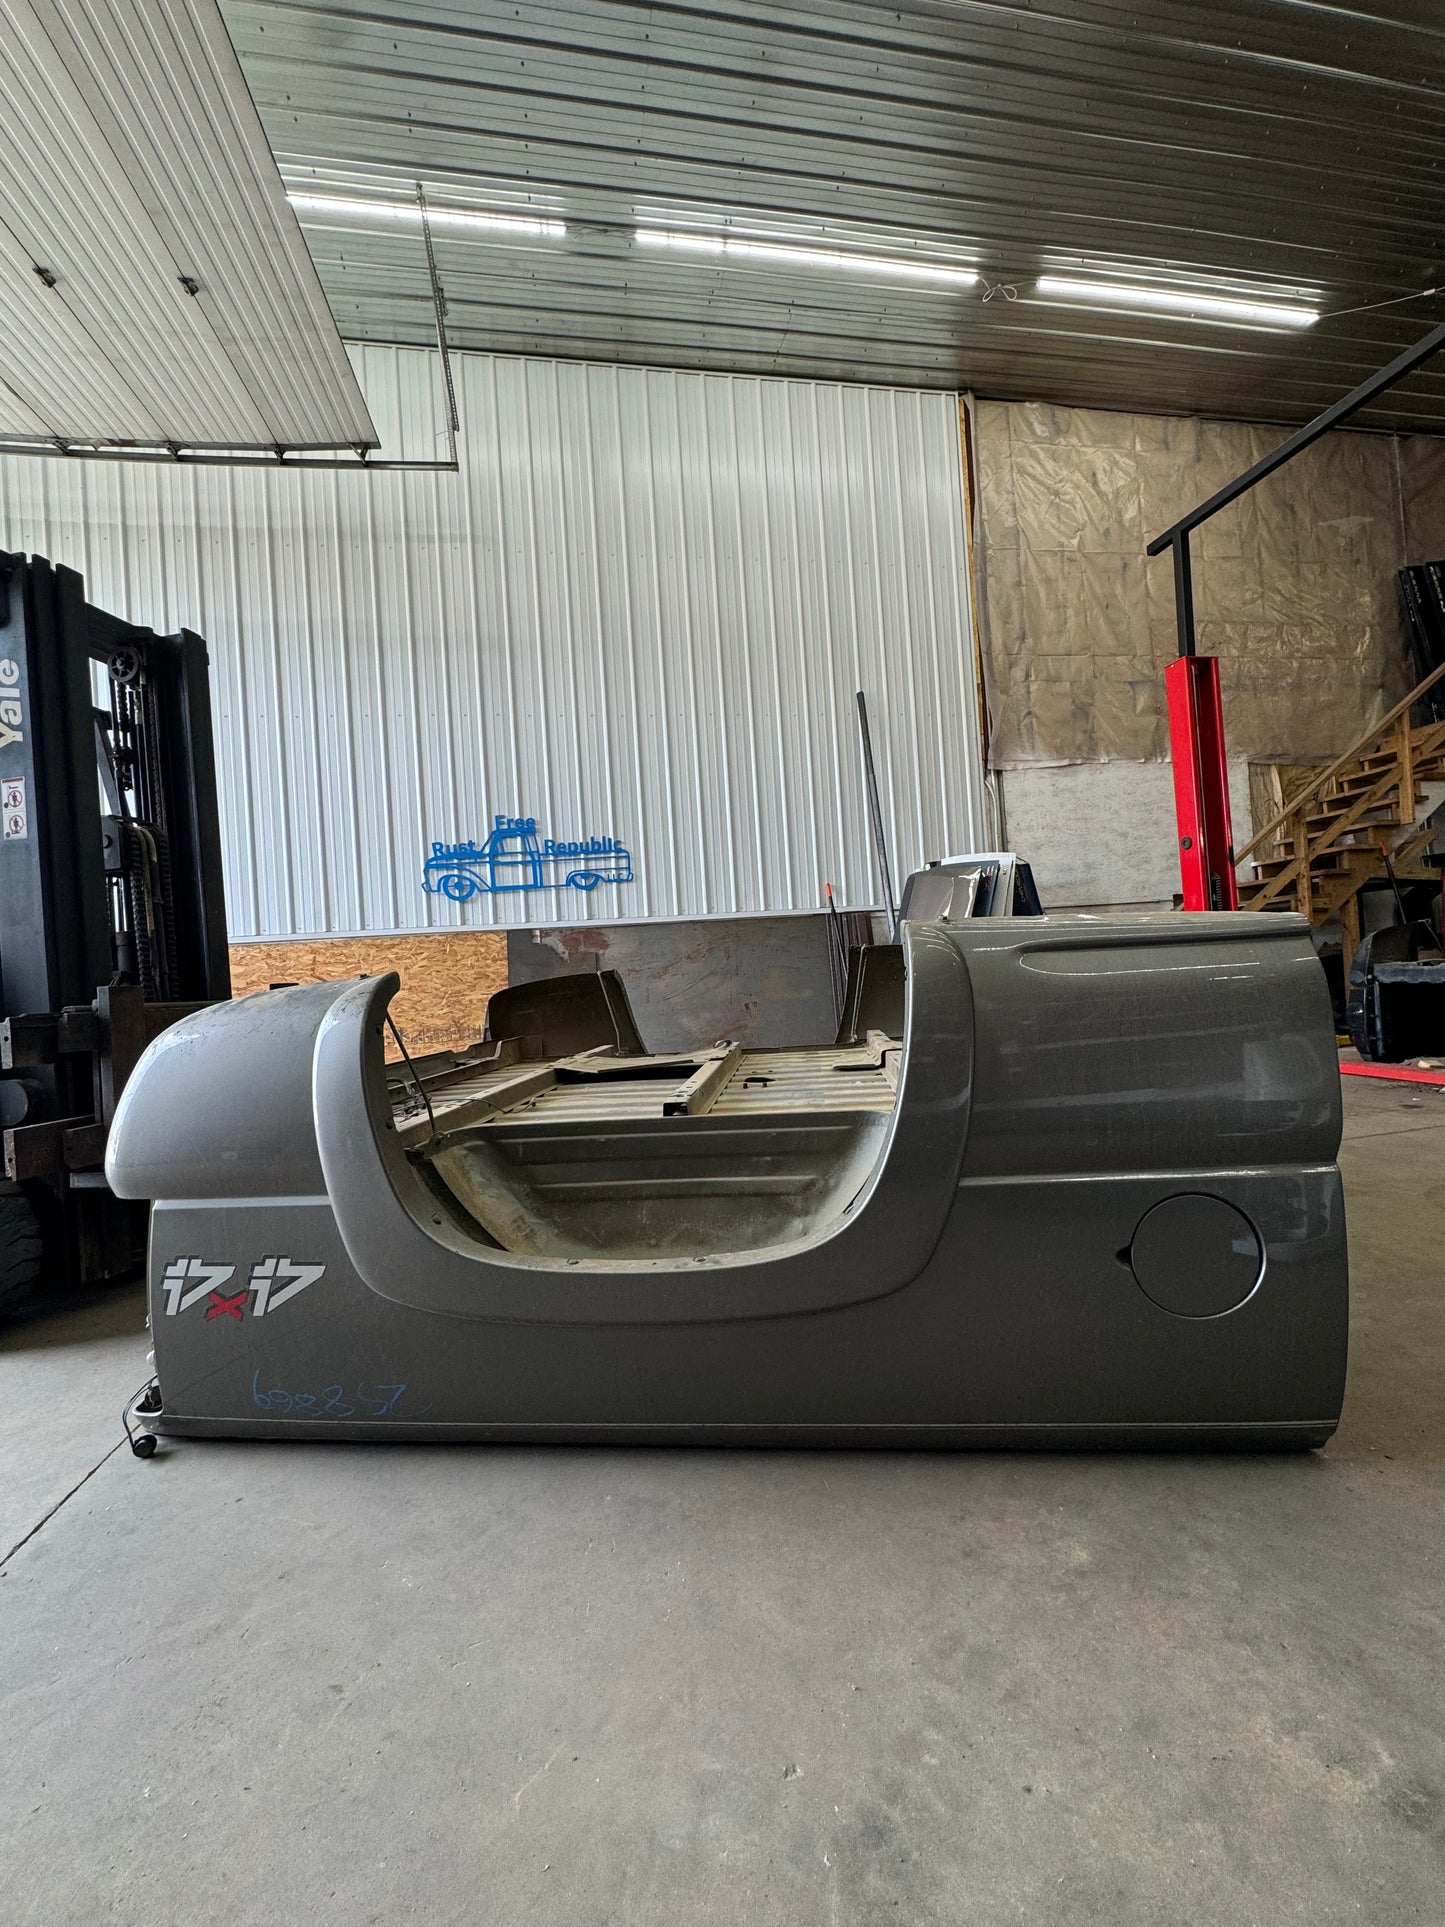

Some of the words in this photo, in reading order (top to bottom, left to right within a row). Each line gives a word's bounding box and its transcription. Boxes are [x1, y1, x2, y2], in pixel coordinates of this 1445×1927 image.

[0, 659, 24, 749] Yale
[494, 815, 536, 831] Free
[431, 840, 476, 857] Rust
[544, 836, 623, 855] Republic
